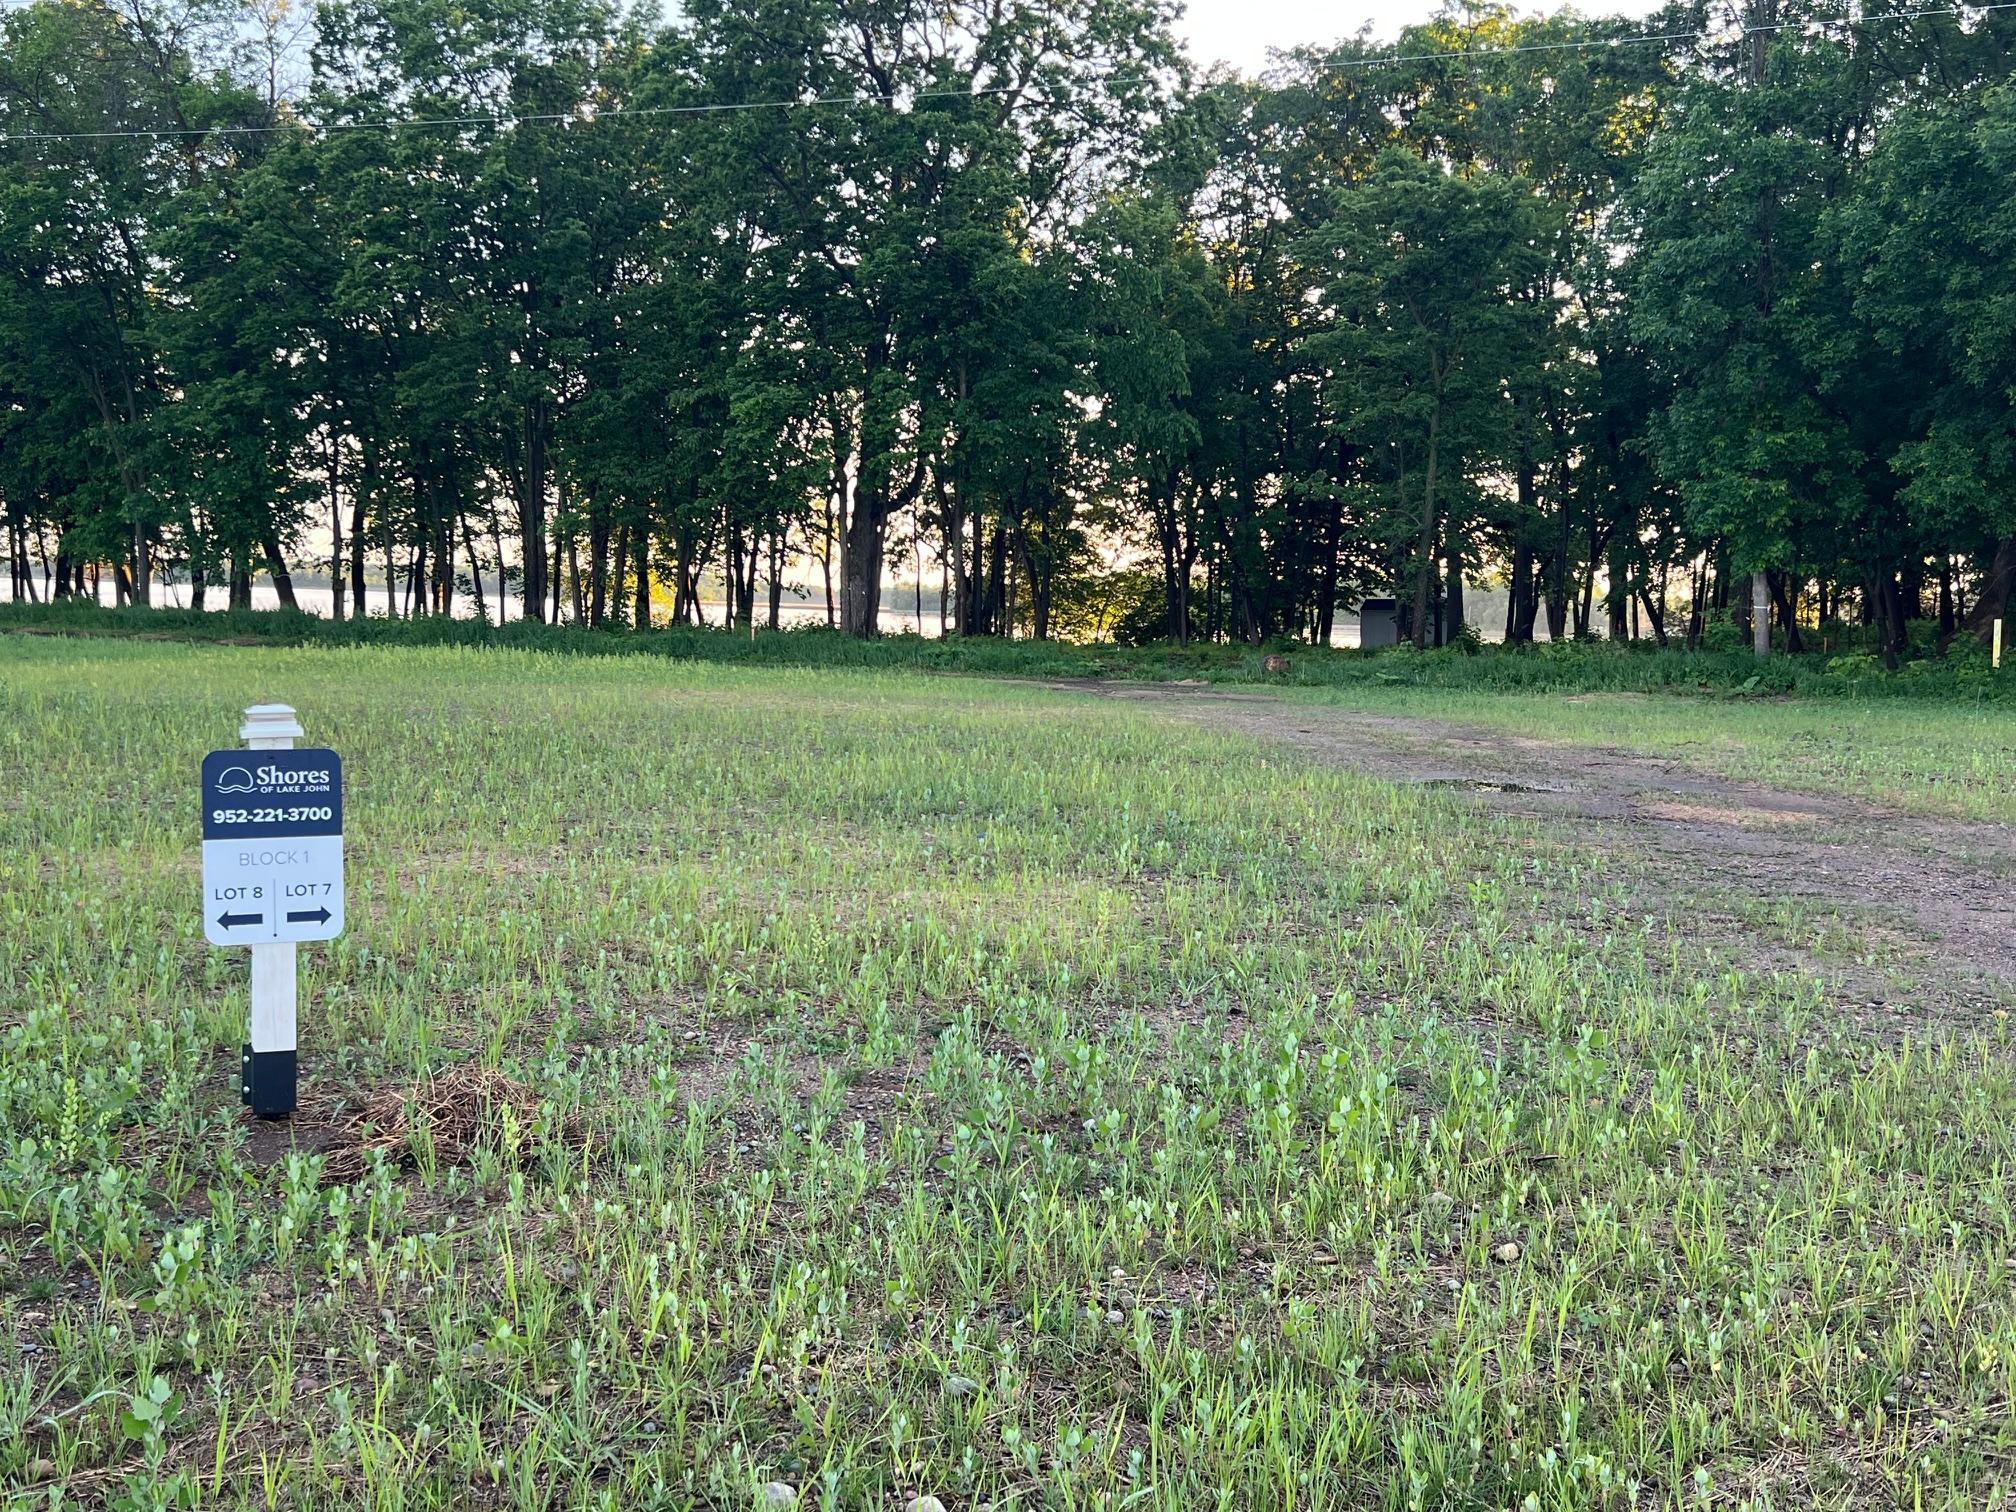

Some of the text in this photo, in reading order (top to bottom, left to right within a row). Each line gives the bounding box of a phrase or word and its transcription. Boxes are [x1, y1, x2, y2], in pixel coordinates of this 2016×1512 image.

[257, 765, 329, 784] Shores
[213, 807, 332, 823] 952-221-3700
[239, 851, 309, 866] BLOCK 1
[215, 887, 263, 900] LOT 8
[286, 884, 331, 897] LOT 7
